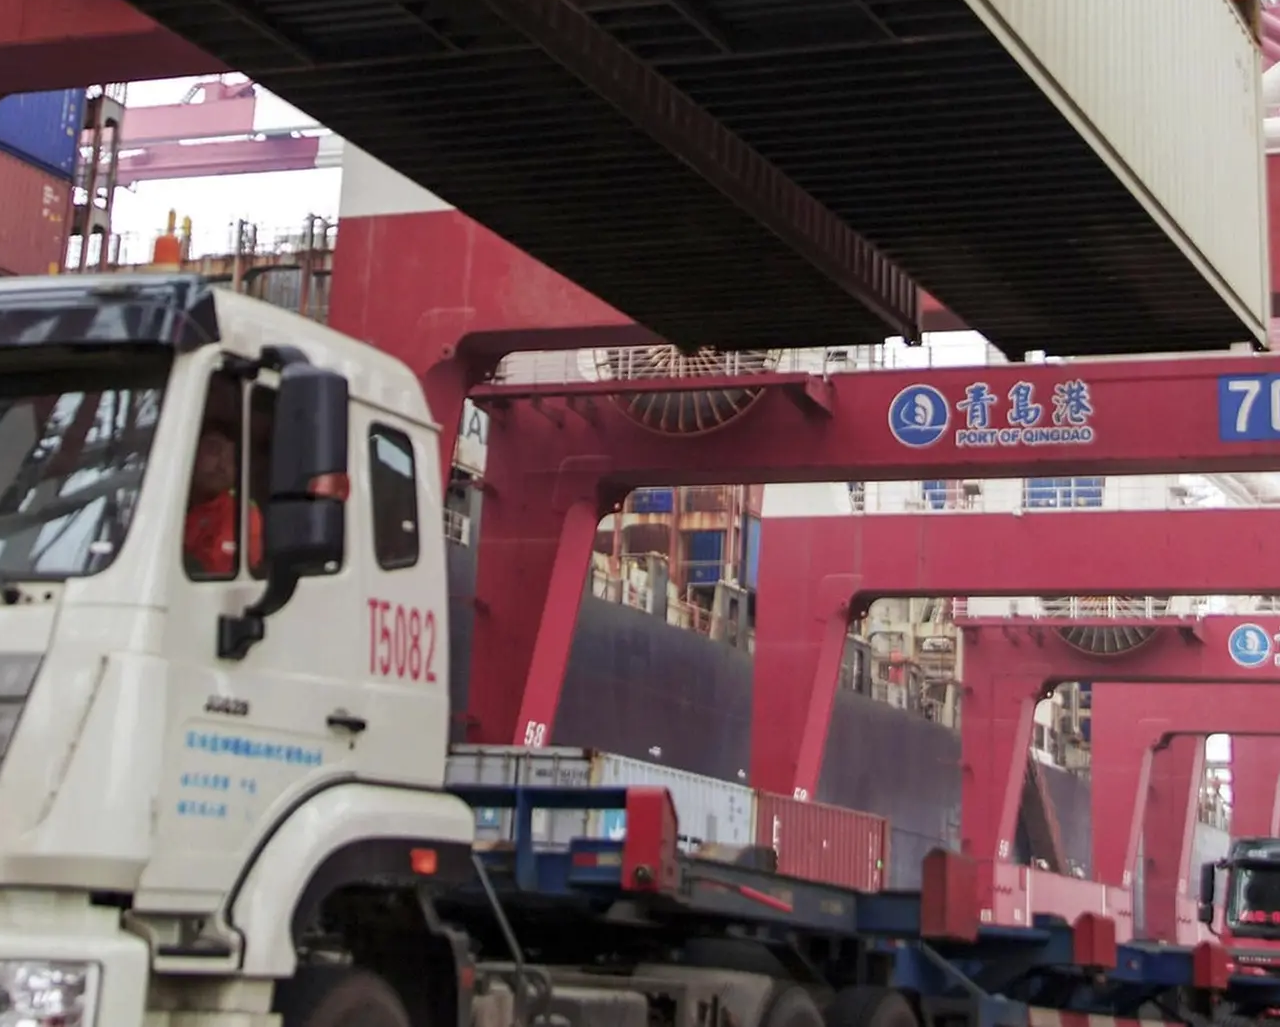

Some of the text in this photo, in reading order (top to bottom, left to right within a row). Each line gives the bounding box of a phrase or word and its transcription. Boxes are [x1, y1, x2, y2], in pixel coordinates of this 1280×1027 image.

[956, 427, 1095, 446] PORT OF QINGDAO
[367, 597, 437, 682] T5082
